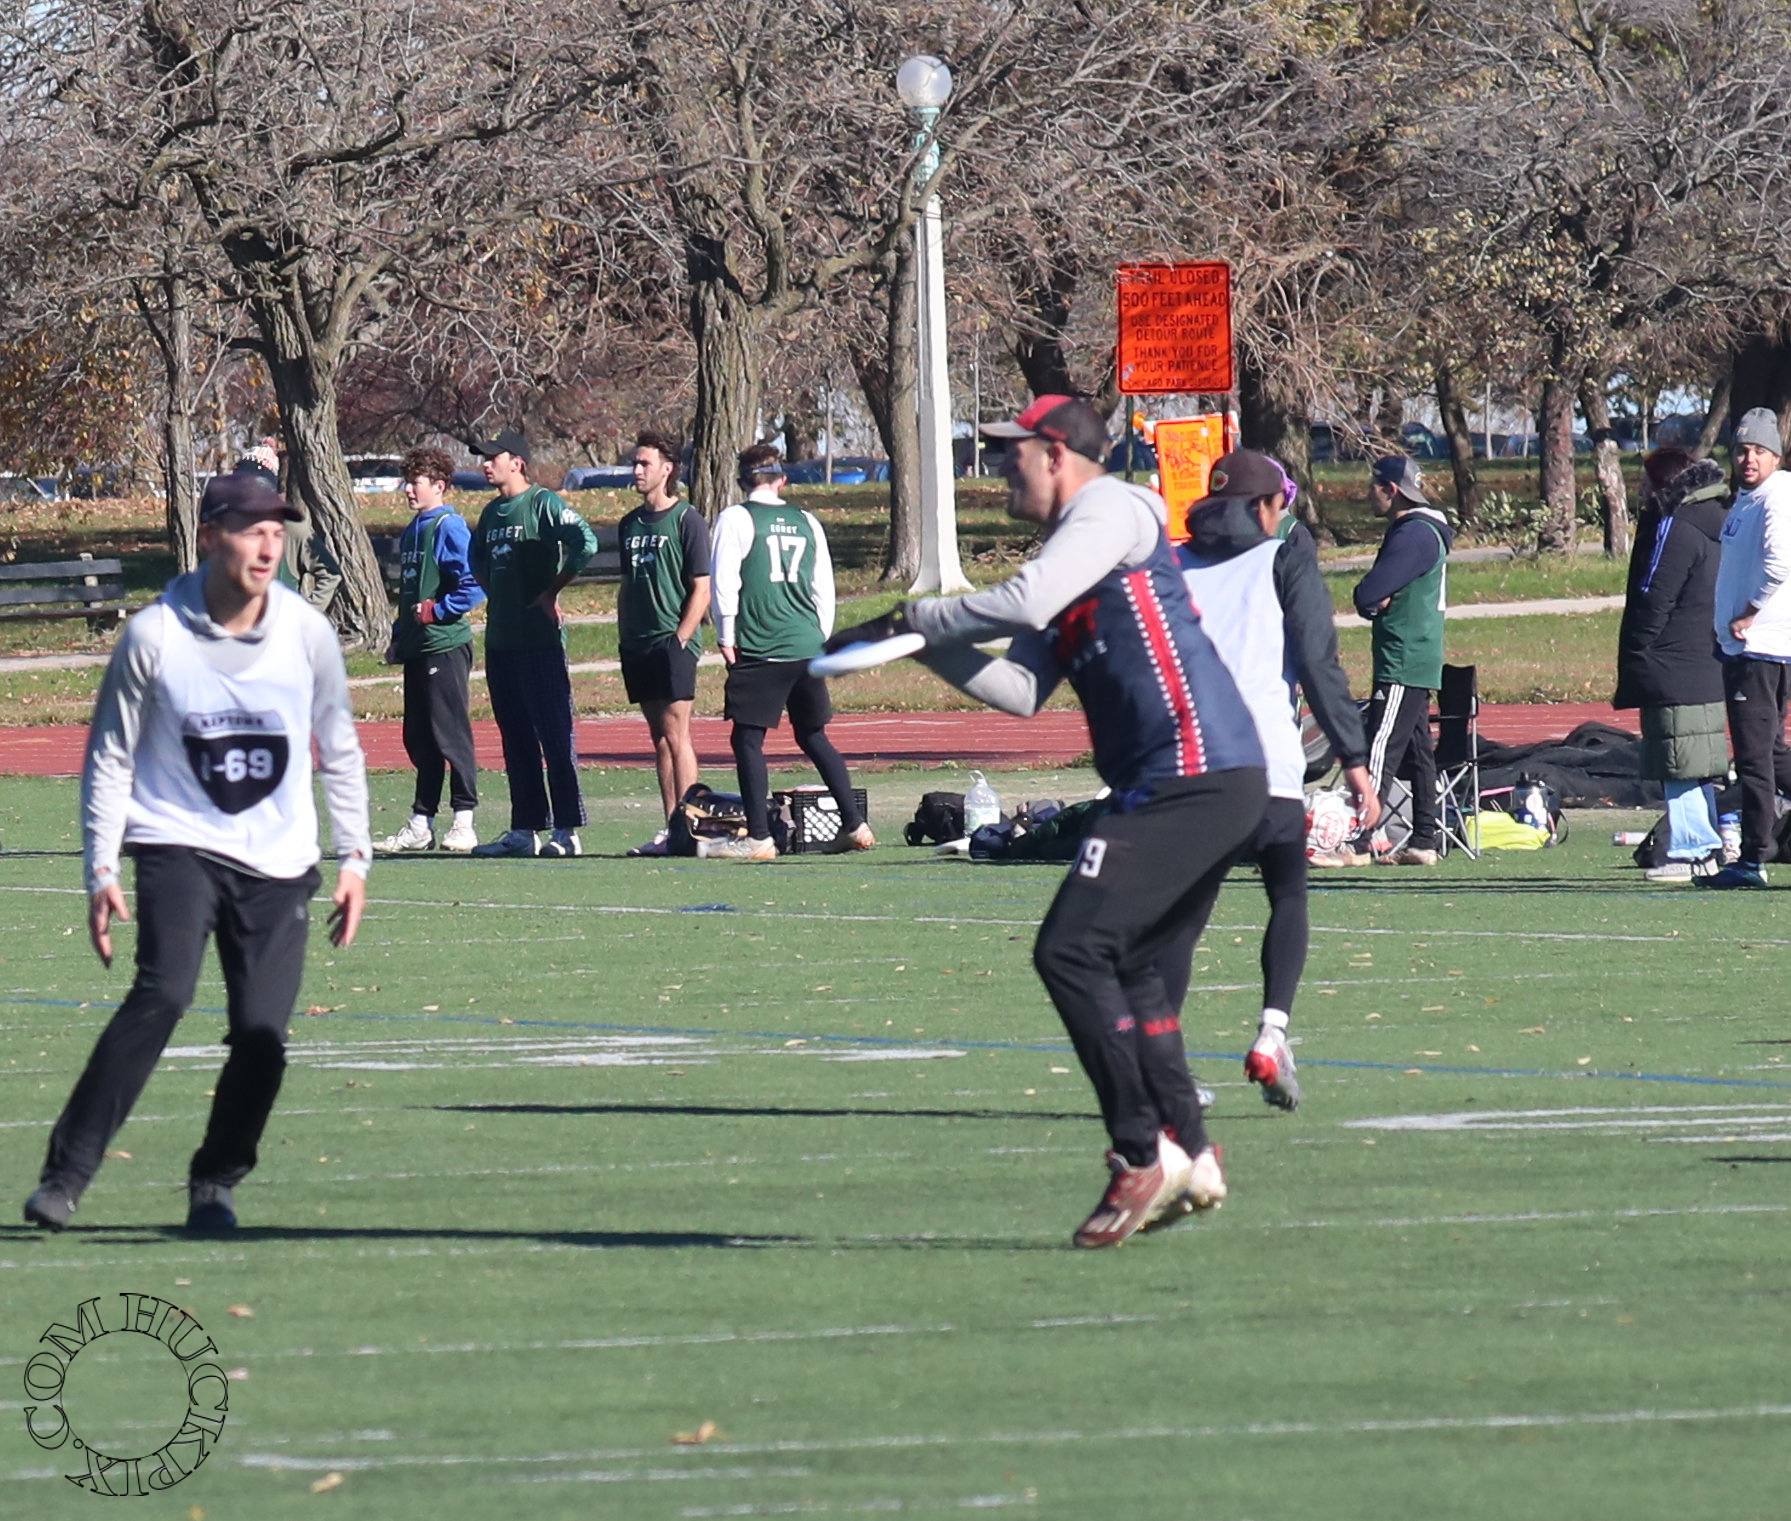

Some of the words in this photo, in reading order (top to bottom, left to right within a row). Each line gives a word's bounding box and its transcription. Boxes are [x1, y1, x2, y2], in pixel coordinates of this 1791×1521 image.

[1170, 270, 1220, 285] CLOSED
[1123, 292, 1149, 307] 500
[1152, 292, 1183, 307] FEET
[1185, 292, 1226, 307] AHEAD
[1131, 314, 1151, 327] USE
[1156, 314, 1219, 327] DESIGNATED
[1136, 328, 1177, 342] DETOUR
[1182, 327, 1215, 340] ROUTE
[1134, 345, 1168, 359] THANK
[1172, 345, 1193, 358] YOU
[1198, 345, 1218, 357] FOR
[1135, 360, 1165, 373] YOUR
[1168, 359, 1218, 372] PATIENCE
[486, 525, 524, 543] EGRET
[625, 534, 669, 550] EGRET
[766, 534, 807, 583] 17
